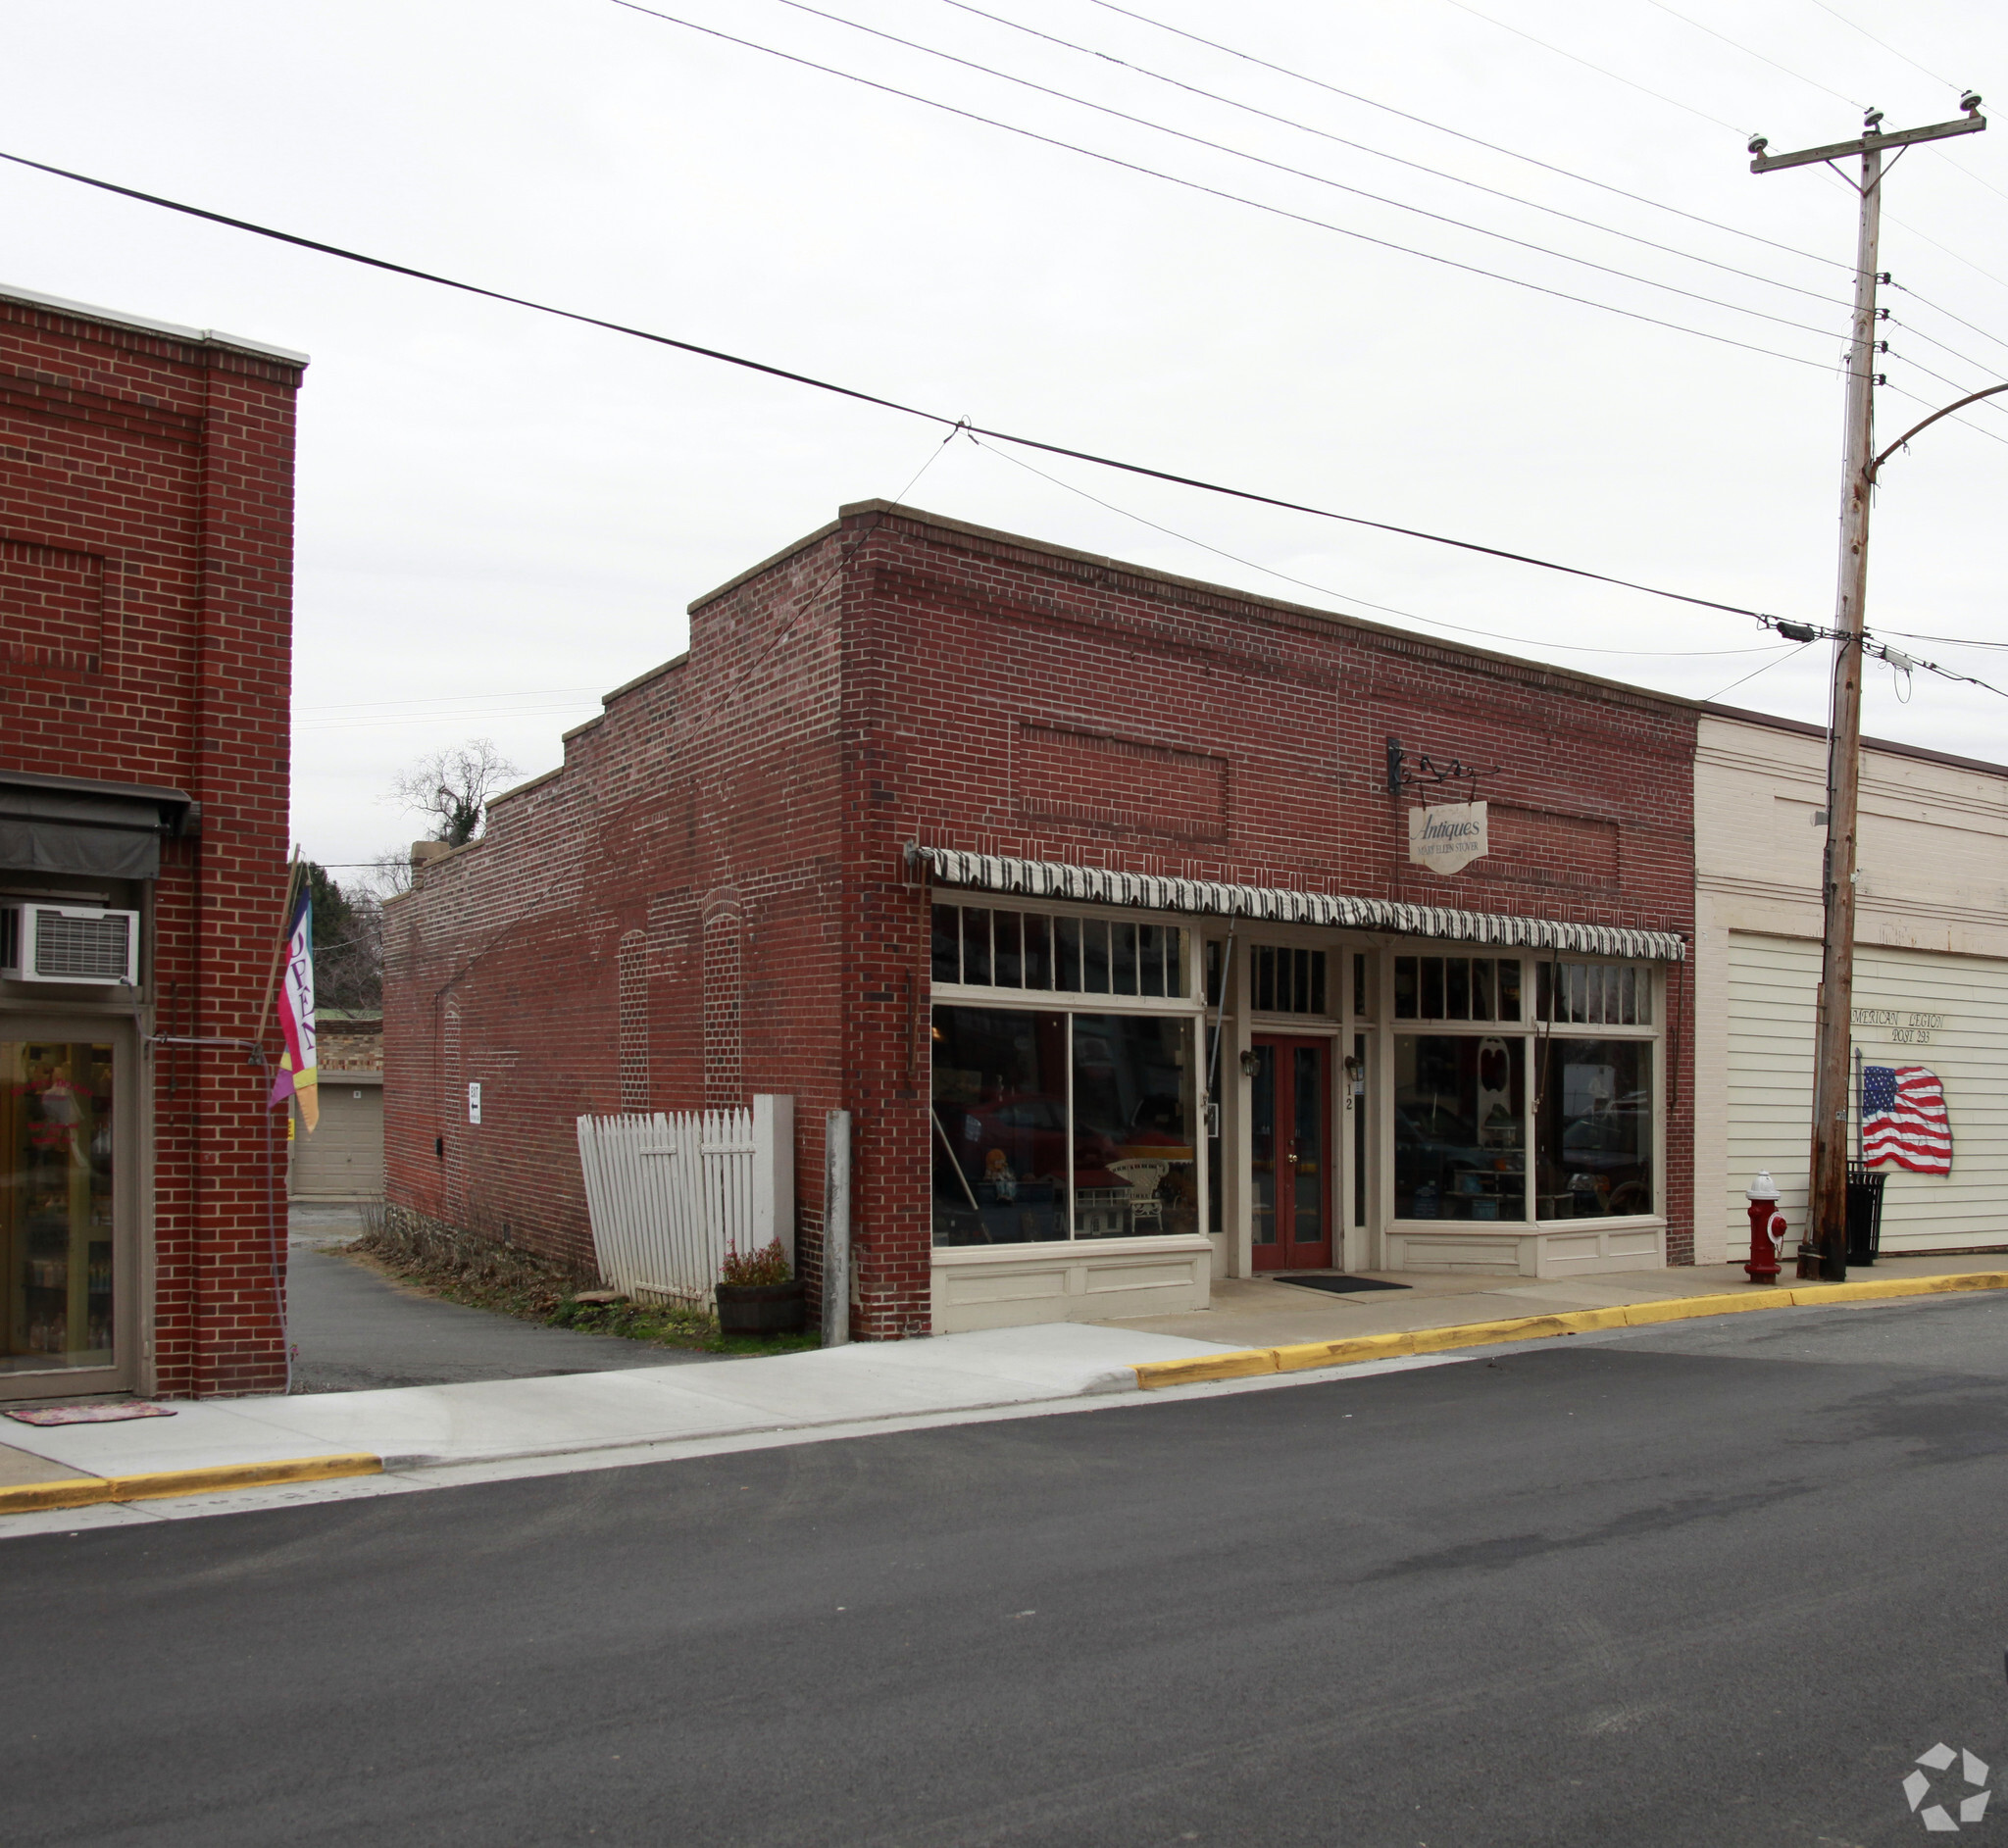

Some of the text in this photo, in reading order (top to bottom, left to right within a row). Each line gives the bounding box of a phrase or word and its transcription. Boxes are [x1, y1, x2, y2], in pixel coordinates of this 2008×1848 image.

[1410, 814, 1480, 840] Antiques
[1418, 841, 1479, 856] MARY ELLEN STOVER
[1850, 1010, 1945, 1028] MERICAN LEGION
[1892, 1028, 1930, 1043] POST 293
